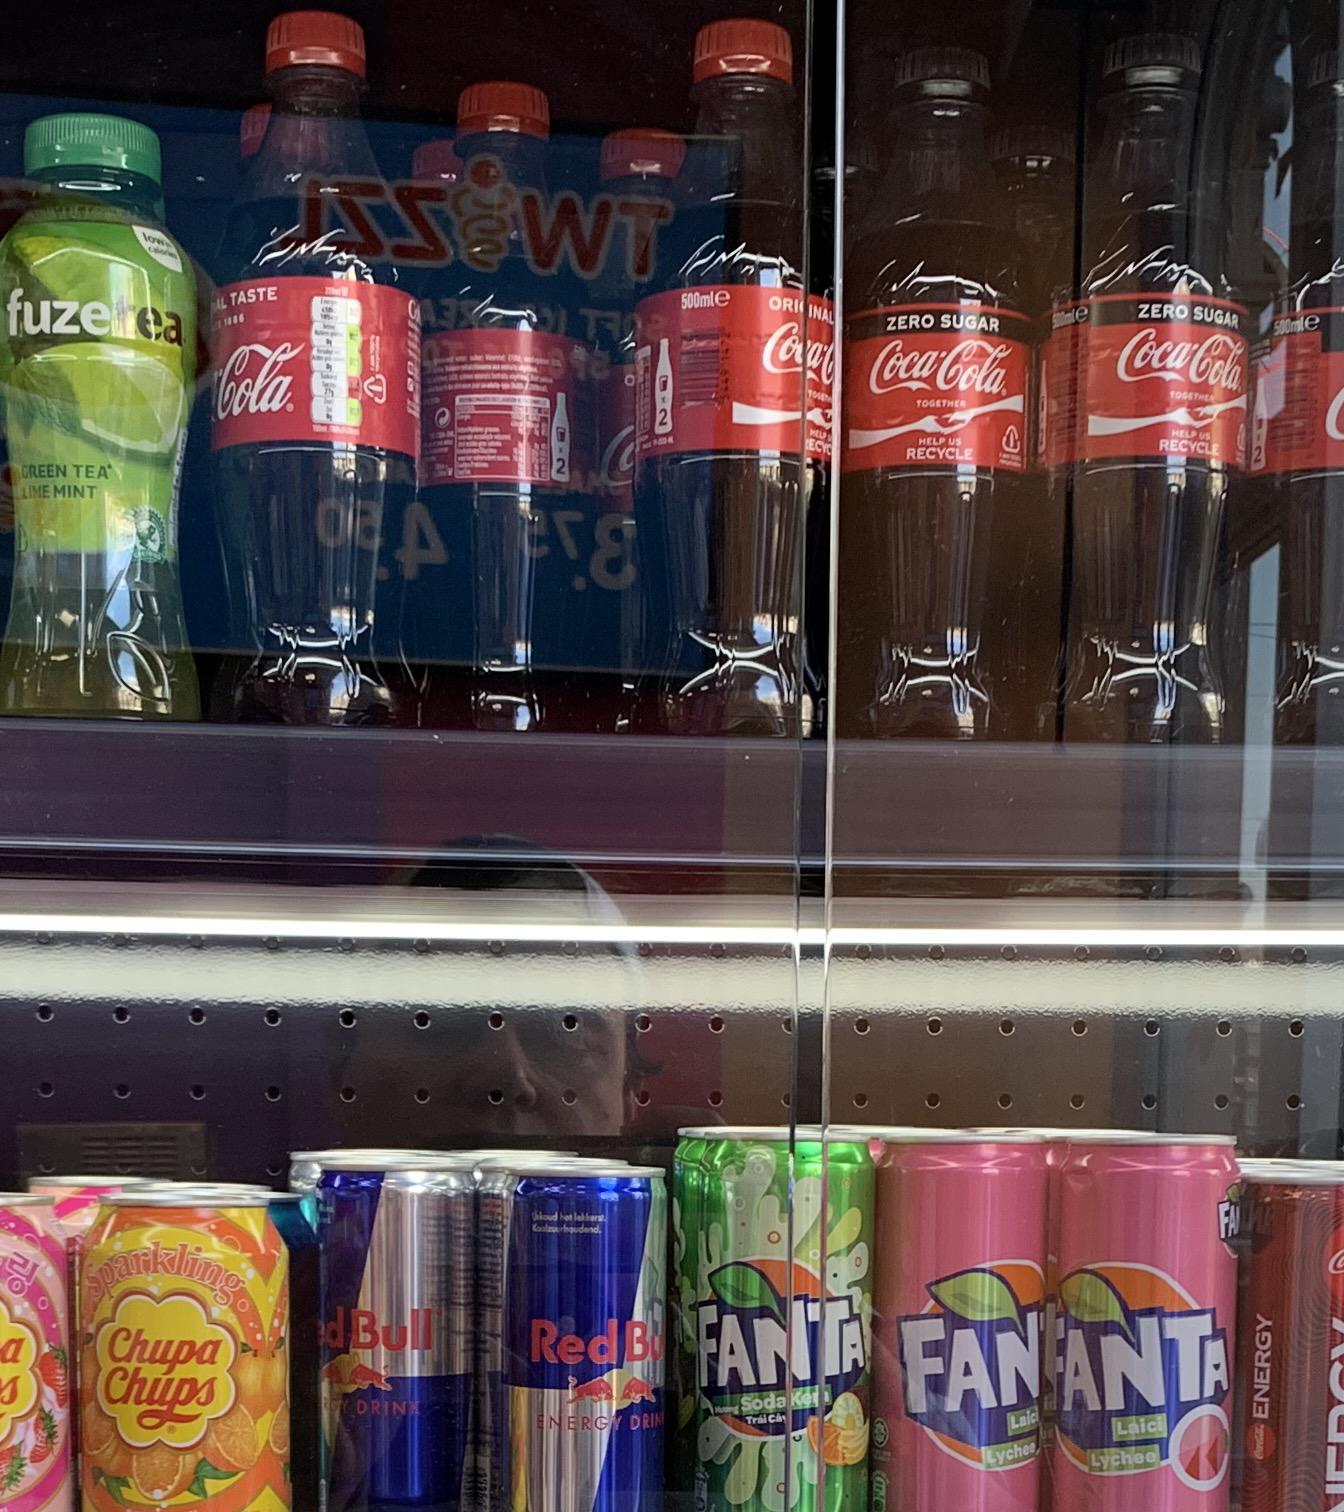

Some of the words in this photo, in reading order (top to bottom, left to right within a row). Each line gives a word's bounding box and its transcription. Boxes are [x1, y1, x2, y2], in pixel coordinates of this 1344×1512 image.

[230, 286, 278, 306] TASTE
[886, 315, 936, 331] ZERO
[940, 315, 1000, 333] SUGAR
[1138, 303, 1187, 321] ZERO
[1191, 306, 1239, 329] SUGAR
[868, 339, 1013, 397] Coca-Cola
[1116, 327, 1242, 392] Coca-Cola
[916, 398, 967, 409] TOGETHER
[906, 448, 974, 461] RECYCLE
[1159, 441, 1220, 456] RECYCLE
[22, 464, 67, 479] GREEN
[52, 485, 98, 500] MINT
[86, 1240, 246, 1308] Sparkling
[352, 1308, 433, 1351] Bull
[108, 1326, 221, 1376] Chupa
[530, 1318, 618, 1365] Red
[697, 1294, 866, 1388] FANTA
[1253, 1313, 1274, 1420] ENERGY
[104, 1367, 217, 1415] Chups
[357, 1401, 420, 1416] DRINK
[740, 1393, 786, 1412] Soda
[536, 1415, 624, 1432] ENERGY
[1089, 1448, 1157, 1470] Lychee
